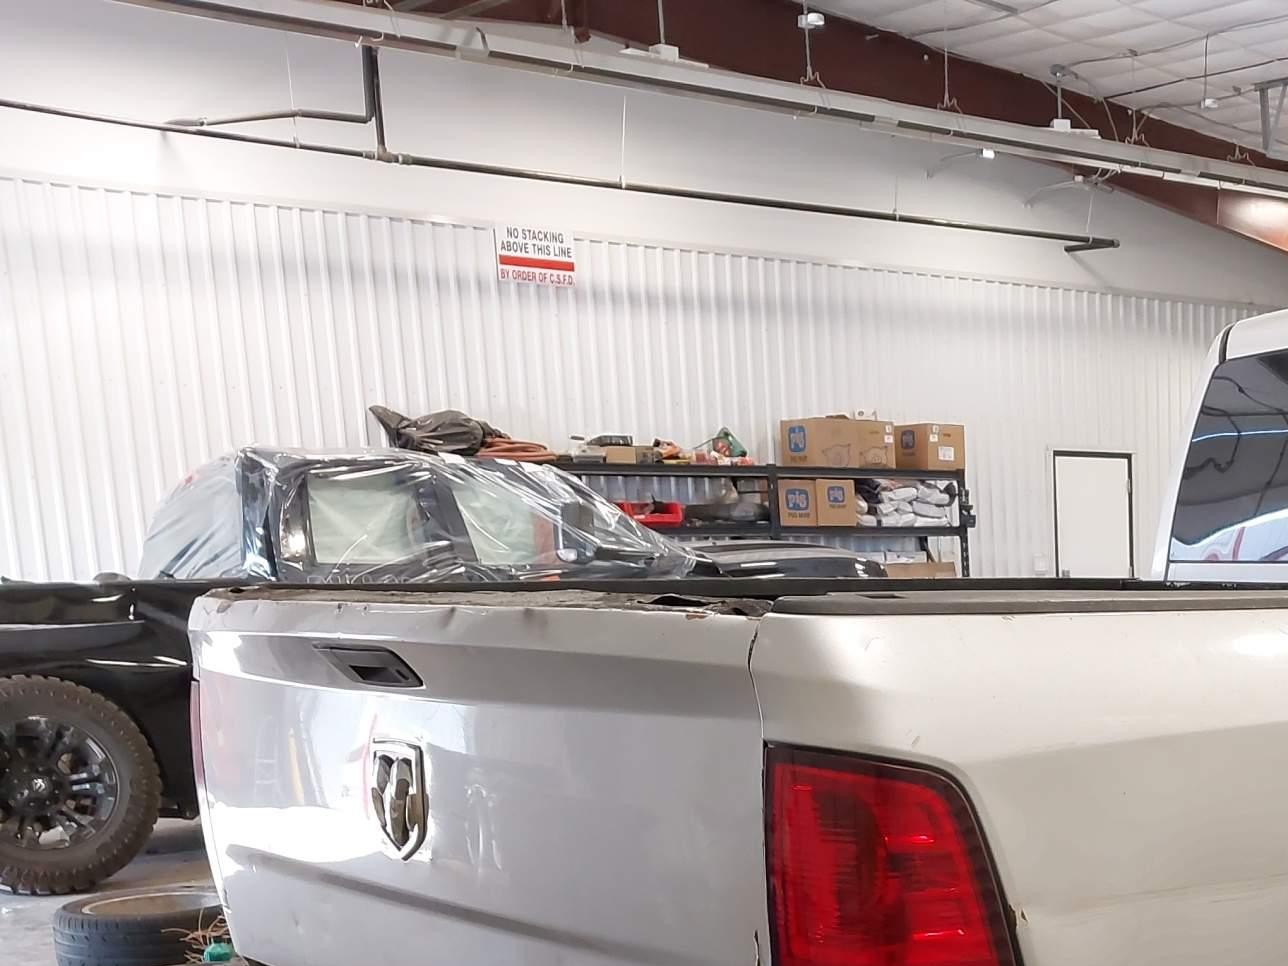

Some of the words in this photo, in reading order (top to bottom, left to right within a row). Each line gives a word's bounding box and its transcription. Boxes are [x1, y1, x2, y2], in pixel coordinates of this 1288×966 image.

[506, 226, 519, 239] NO
[521, 228, 564, 244] STACKING
[500, 240, 530, 254] ABOVE
[532, 243, 551, 256] THIS
[553, 245, 572, 258] LINE
[500, 268, 510, 279] BY
[512, 269, 537, 282] ORDER
[538, 271, 547, 283] OF
